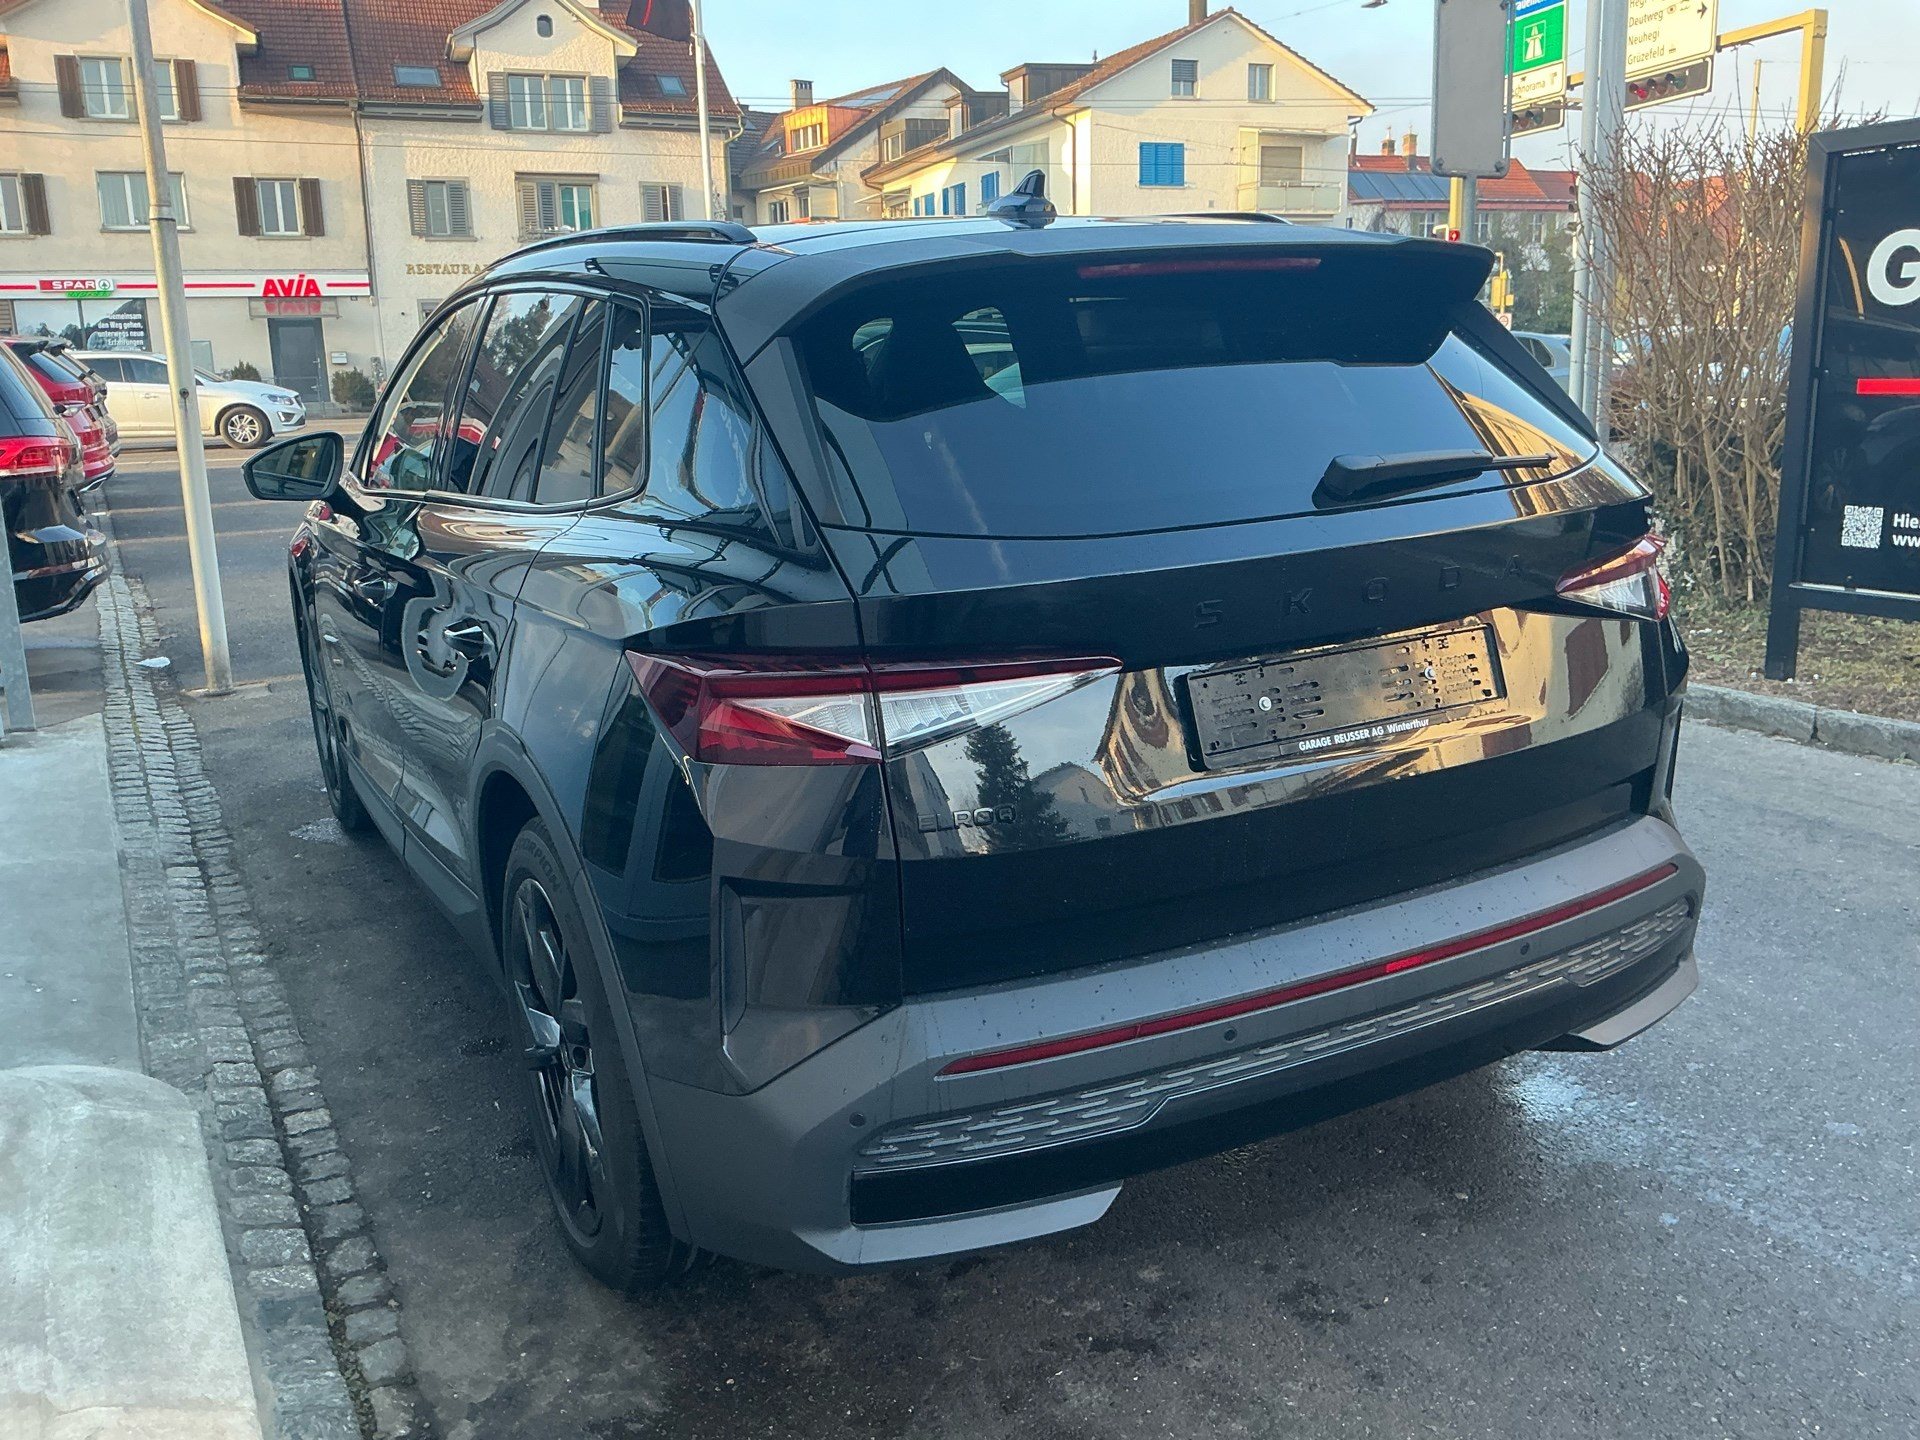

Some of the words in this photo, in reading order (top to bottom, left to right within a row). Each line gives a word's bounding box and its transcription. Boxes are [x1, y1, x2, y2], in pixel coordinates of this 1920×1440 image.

[1629, 10, 1664, 27] Deutweg
[1628, 28, 1660, 46] Neuhegi
[406, 264, 490, 275] RESTAURA
[52, 281, 96, 290] SPAR
[1893, 513, 1920, 529] Hie
[1299, 736, 1332, 751] GARAGE
[1334, 729, 1370, 745] REUSSER
[1371, 726, 1385, 737] AG
[1387, 718, 1430, 734] Winterthur
